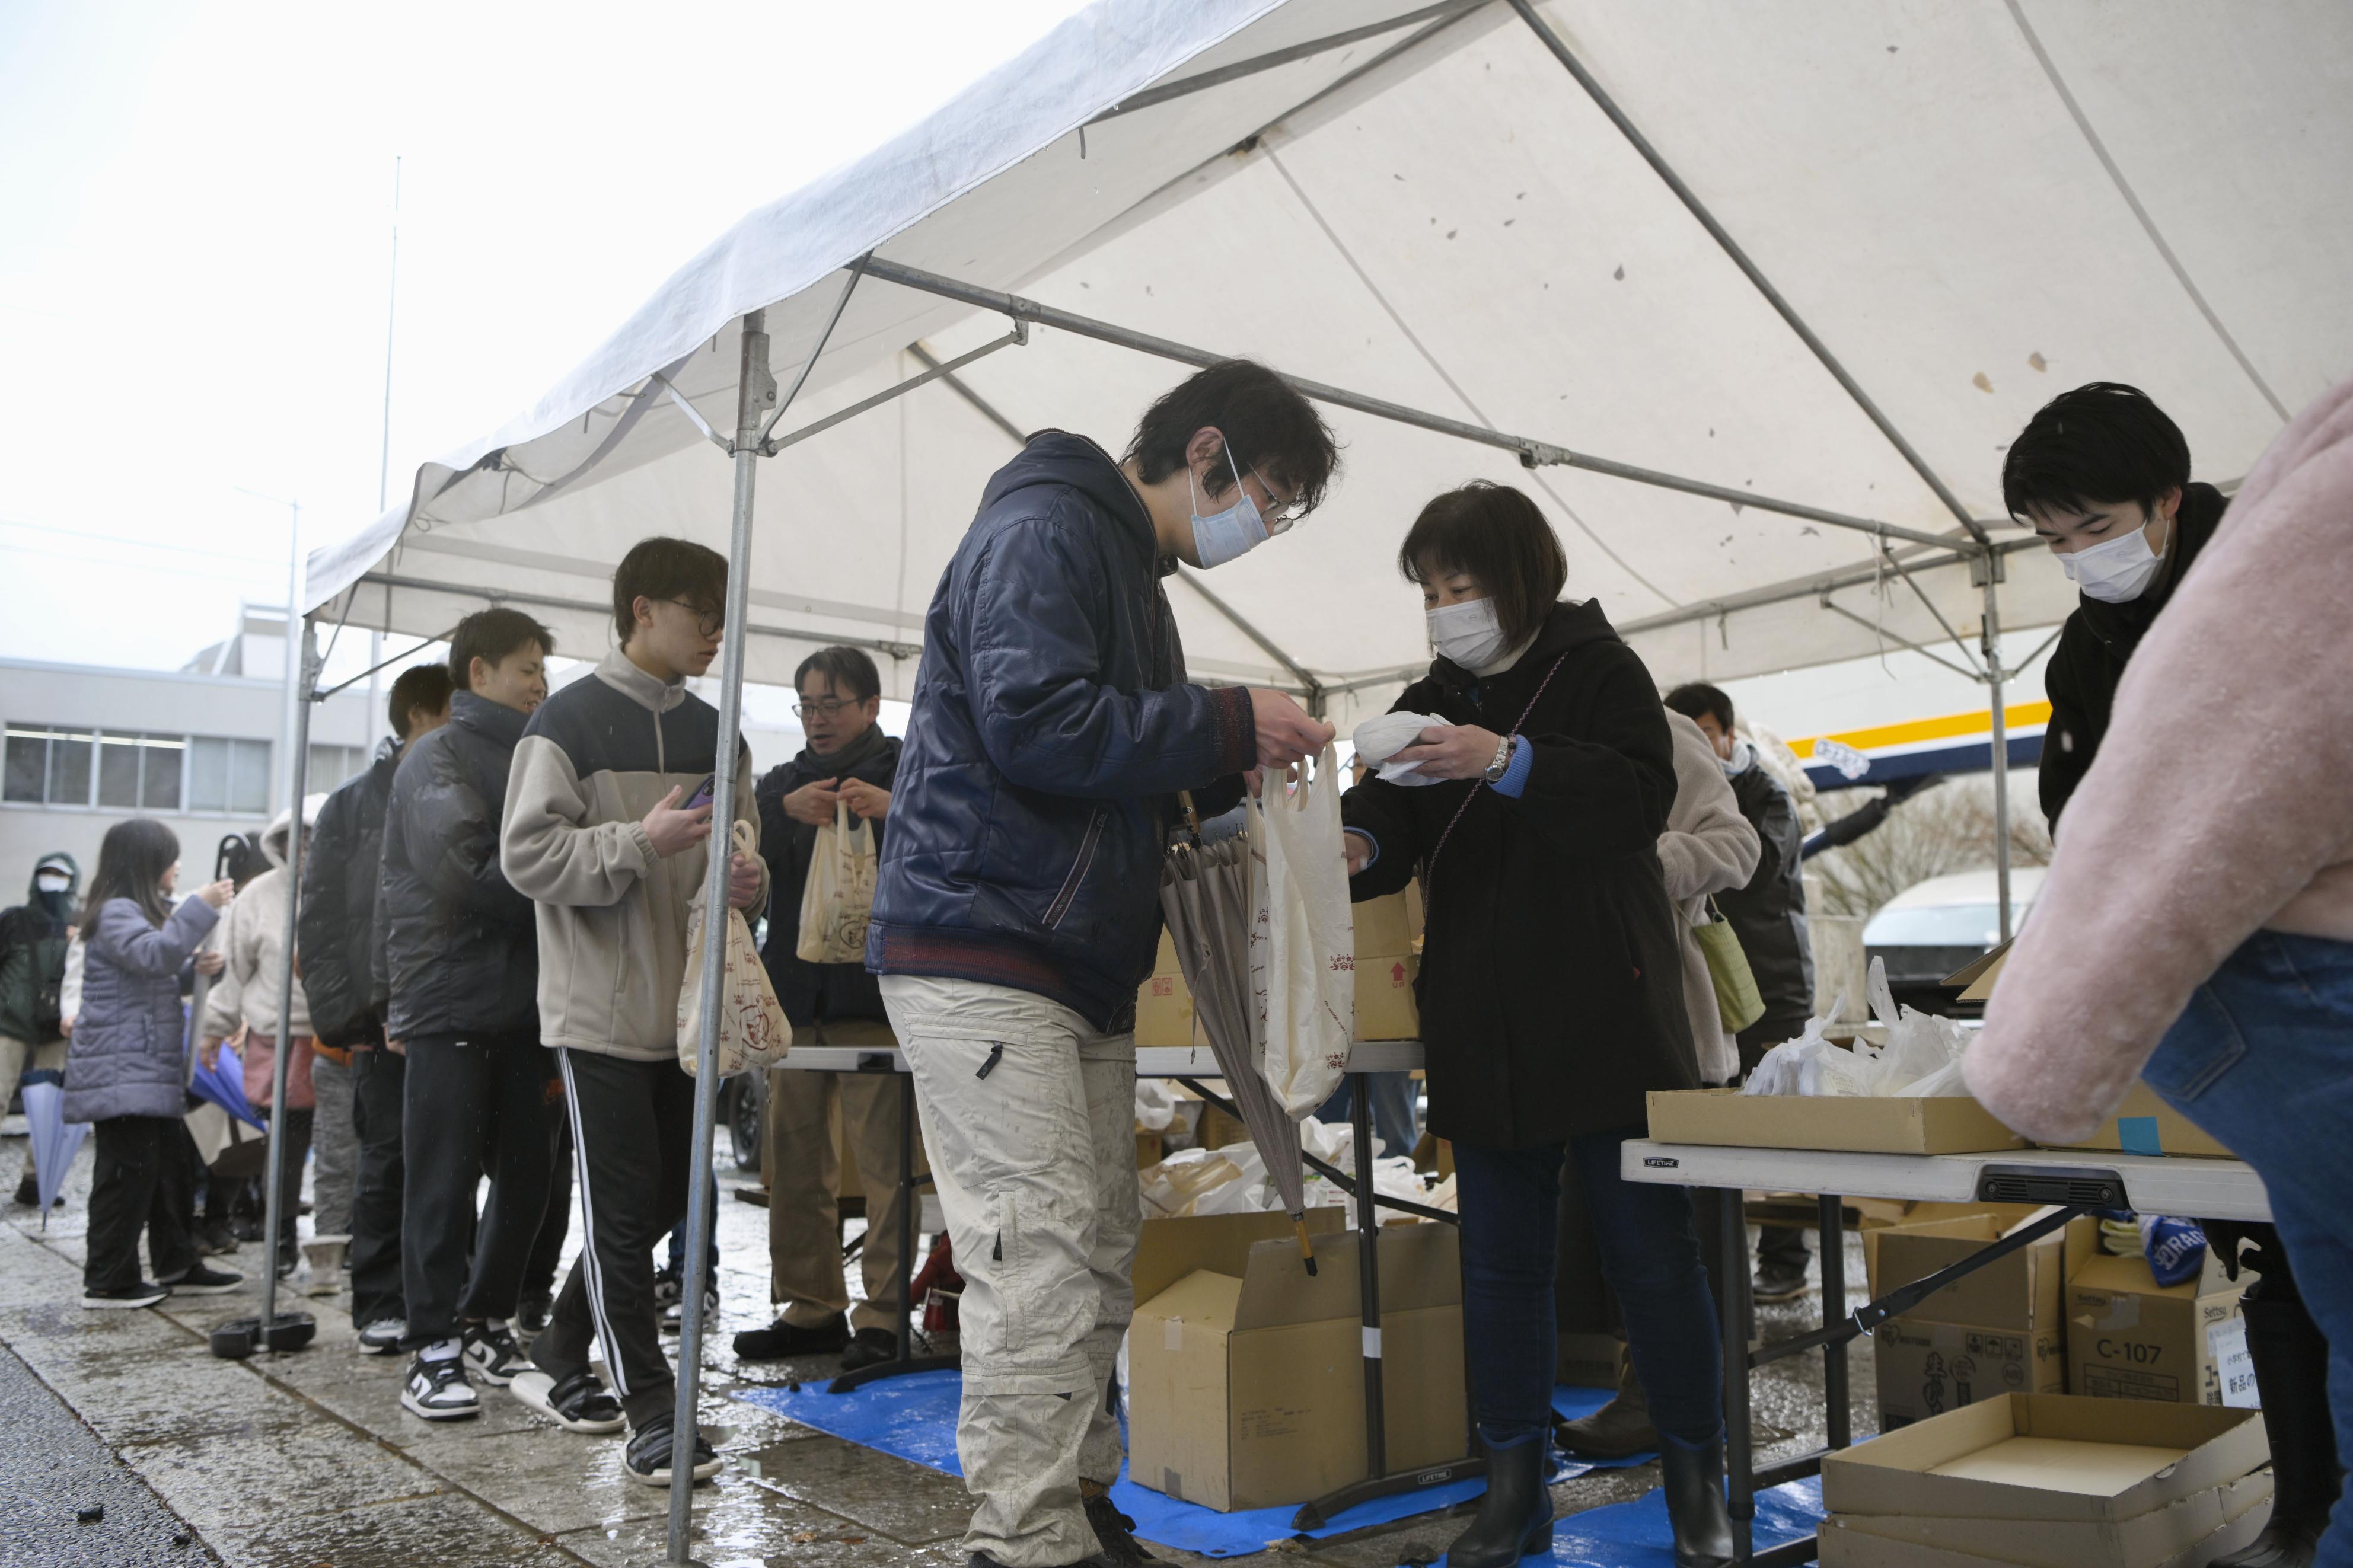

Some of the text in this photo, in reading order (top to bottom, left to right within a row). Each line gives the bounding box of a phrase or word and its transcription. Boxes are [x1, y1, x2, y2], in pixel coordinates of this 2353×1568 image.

[2204, 1306, 2227, 1320] Settsu
[2096, 1338, 2163, 1365] C-107
[2229, 1372, 2256, 1395] 新品の
